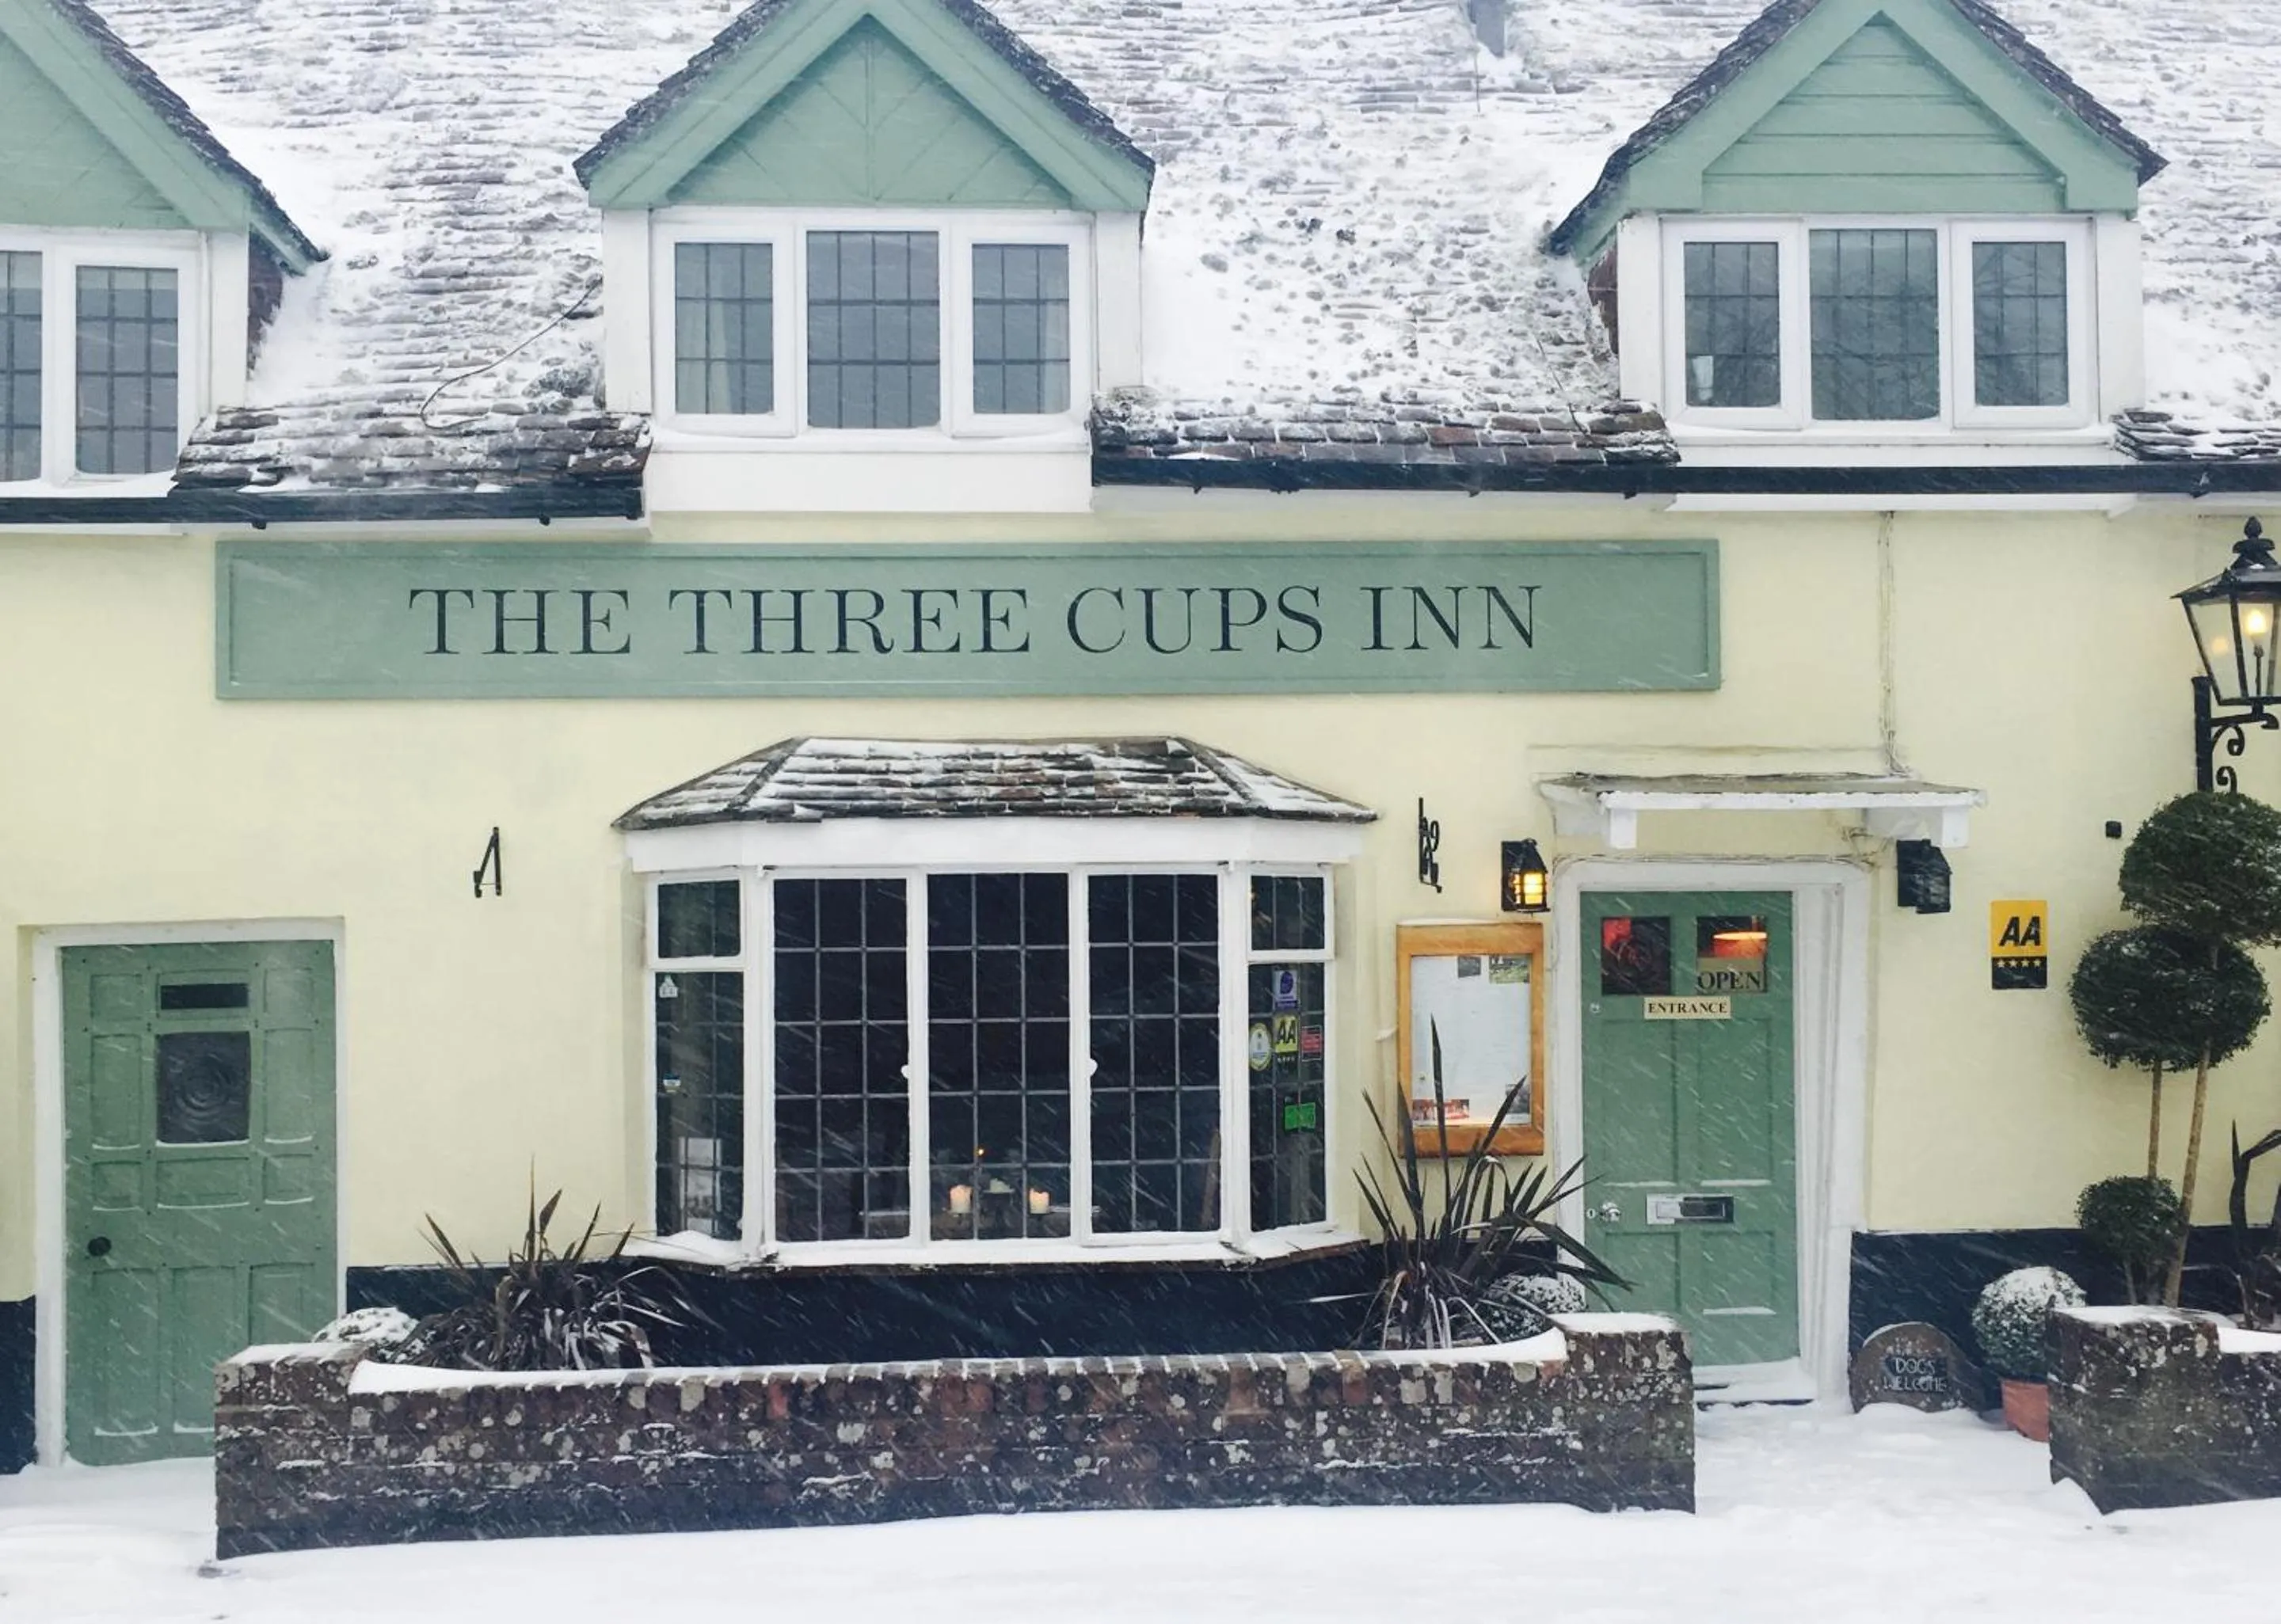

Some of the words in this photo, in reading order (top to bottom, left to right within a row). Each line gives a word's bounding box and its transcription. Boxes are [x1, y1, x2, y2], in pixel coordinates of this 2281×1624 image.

[408, 588, 630, 655] THE
[669, 588, 1030, 654] THREE
[1068, 585, 1323, 655] CUPS
[1360, 585, 1542, 651] INN
[1998, 916, 2041, 946] AA
[1697, 971, 1761, 990] OPEN
[1647, 1002, 1728, 1014] ENTRANCE
[1278, 1019, 1297, 1044] AA
[1895, 1358, 1936, 1375] DOGS
